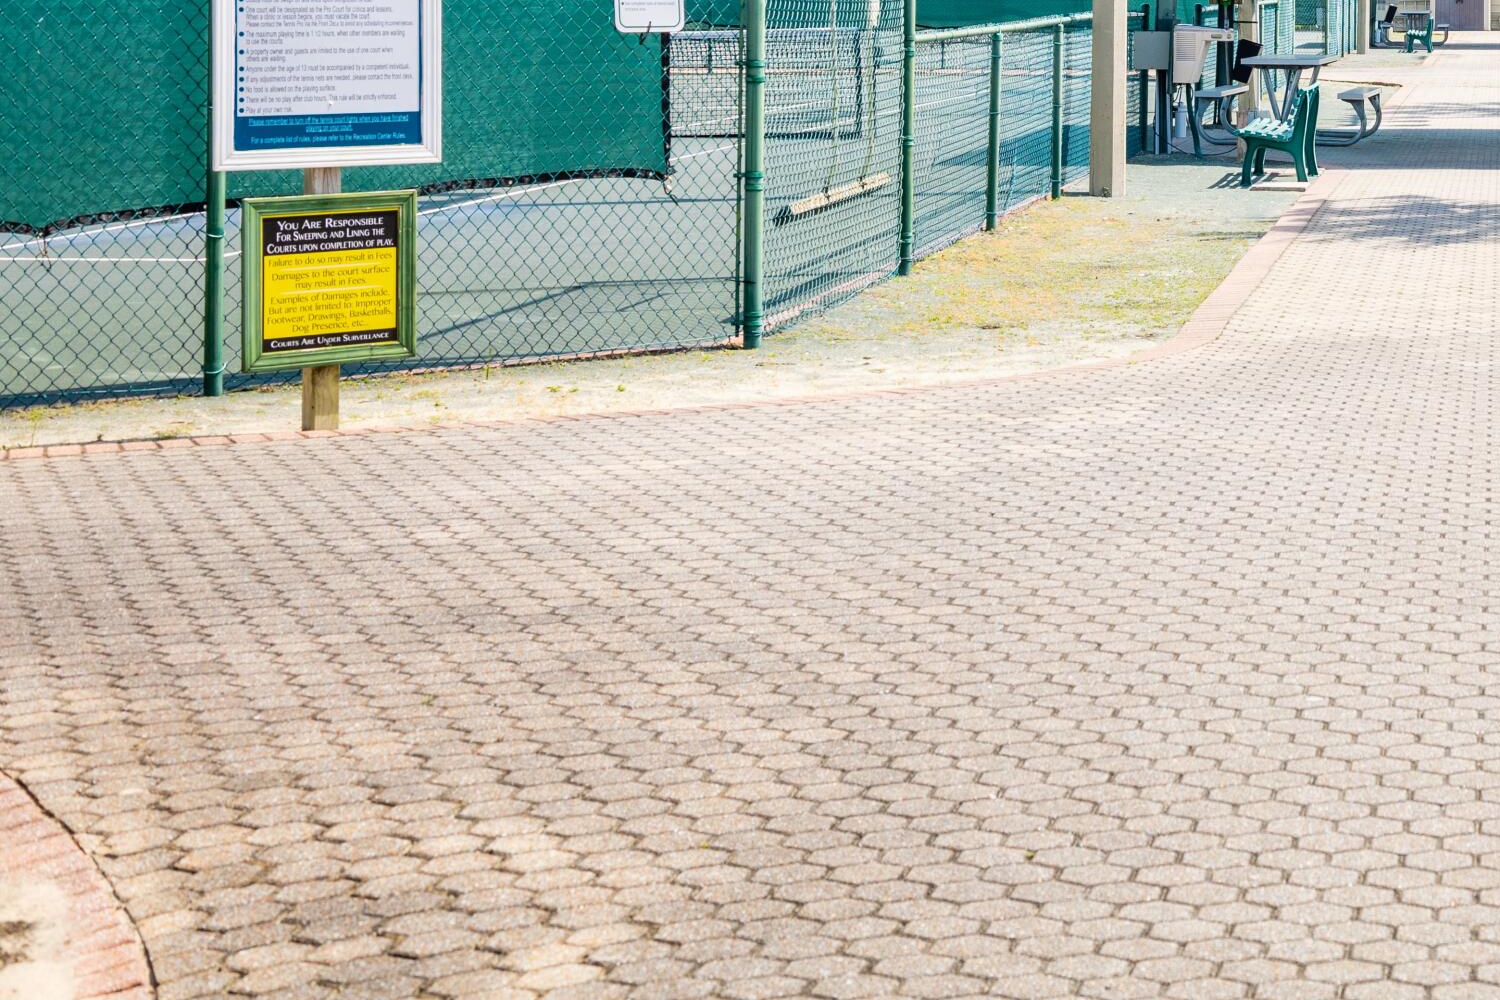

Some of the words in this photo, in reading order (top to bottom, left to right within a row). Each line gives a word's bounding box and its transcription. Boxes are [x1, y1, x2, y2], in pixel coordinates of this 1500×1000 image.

[277, 220, 298, 230] YOU
[302, 220, 322, 230] ARE
[326, 217, 384, 228] RESPONSIBLE
[276, 232, 292, 242] FOR
[293, 231, 328, 241] SWEEPING
[330, 230, 344, 239] AND
[346, 228, 370, 238] LINING
[372, 228, 384, 236] THE
[267, 244, 296, 254] COURTS
[298, 244, 318, 252] UPON
[320, 240, 364, 250] COMPLETION
[377, 238, 394, 246] PLAY.
[268, 258, 292, 267] Failure
[305, 256, 314, 265] do
[346, 252, 365, 262] result
[272, 272, 309, 281] Damages
[322, 268, 335, 277] the
[338, 268, 358, 276] court
[362, 265, 390, 274] surface
[295, 282, 312, 290] may
[315, 278, 336, 287] result
[339, 278, 345, 286] in
[271, 295, 308, 304] Examples
[311, 292, 319, 301] of
[322, 292, 358, 301] Damages
[269, 307, 282, 315] But
[315, 302, 341, 311] limited
[356, 299, 392, 310] Improper
[292, 324, 309, 334] Dog
